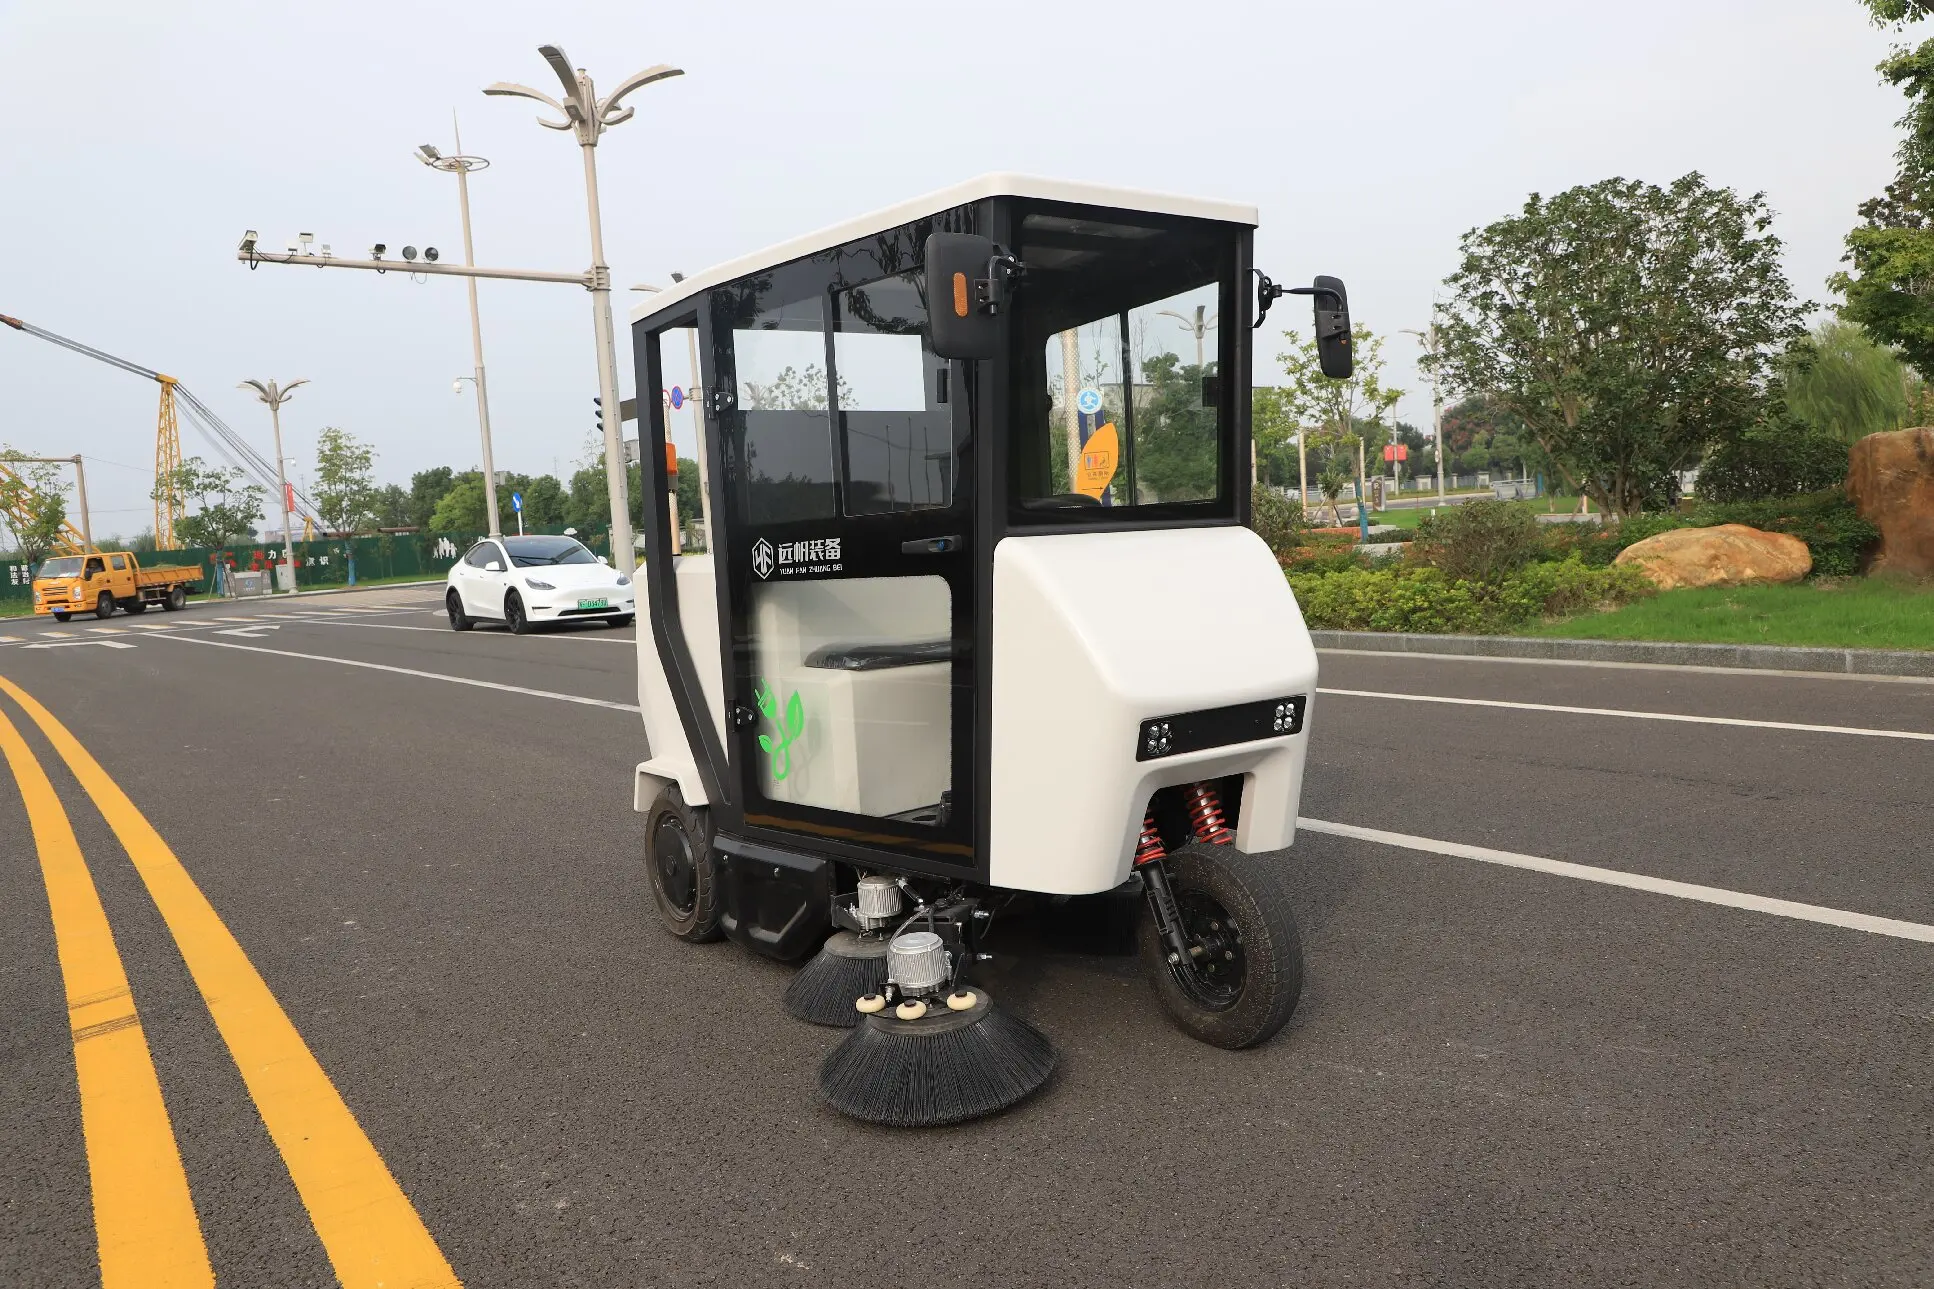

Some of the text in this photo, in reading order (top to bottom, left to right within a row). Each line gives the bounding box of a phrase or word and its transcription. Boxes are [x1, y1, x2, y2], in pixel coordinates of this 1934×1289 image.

[778, 537, 841, 564] 远帆装备
[832, 563, 843, 571] BEI
